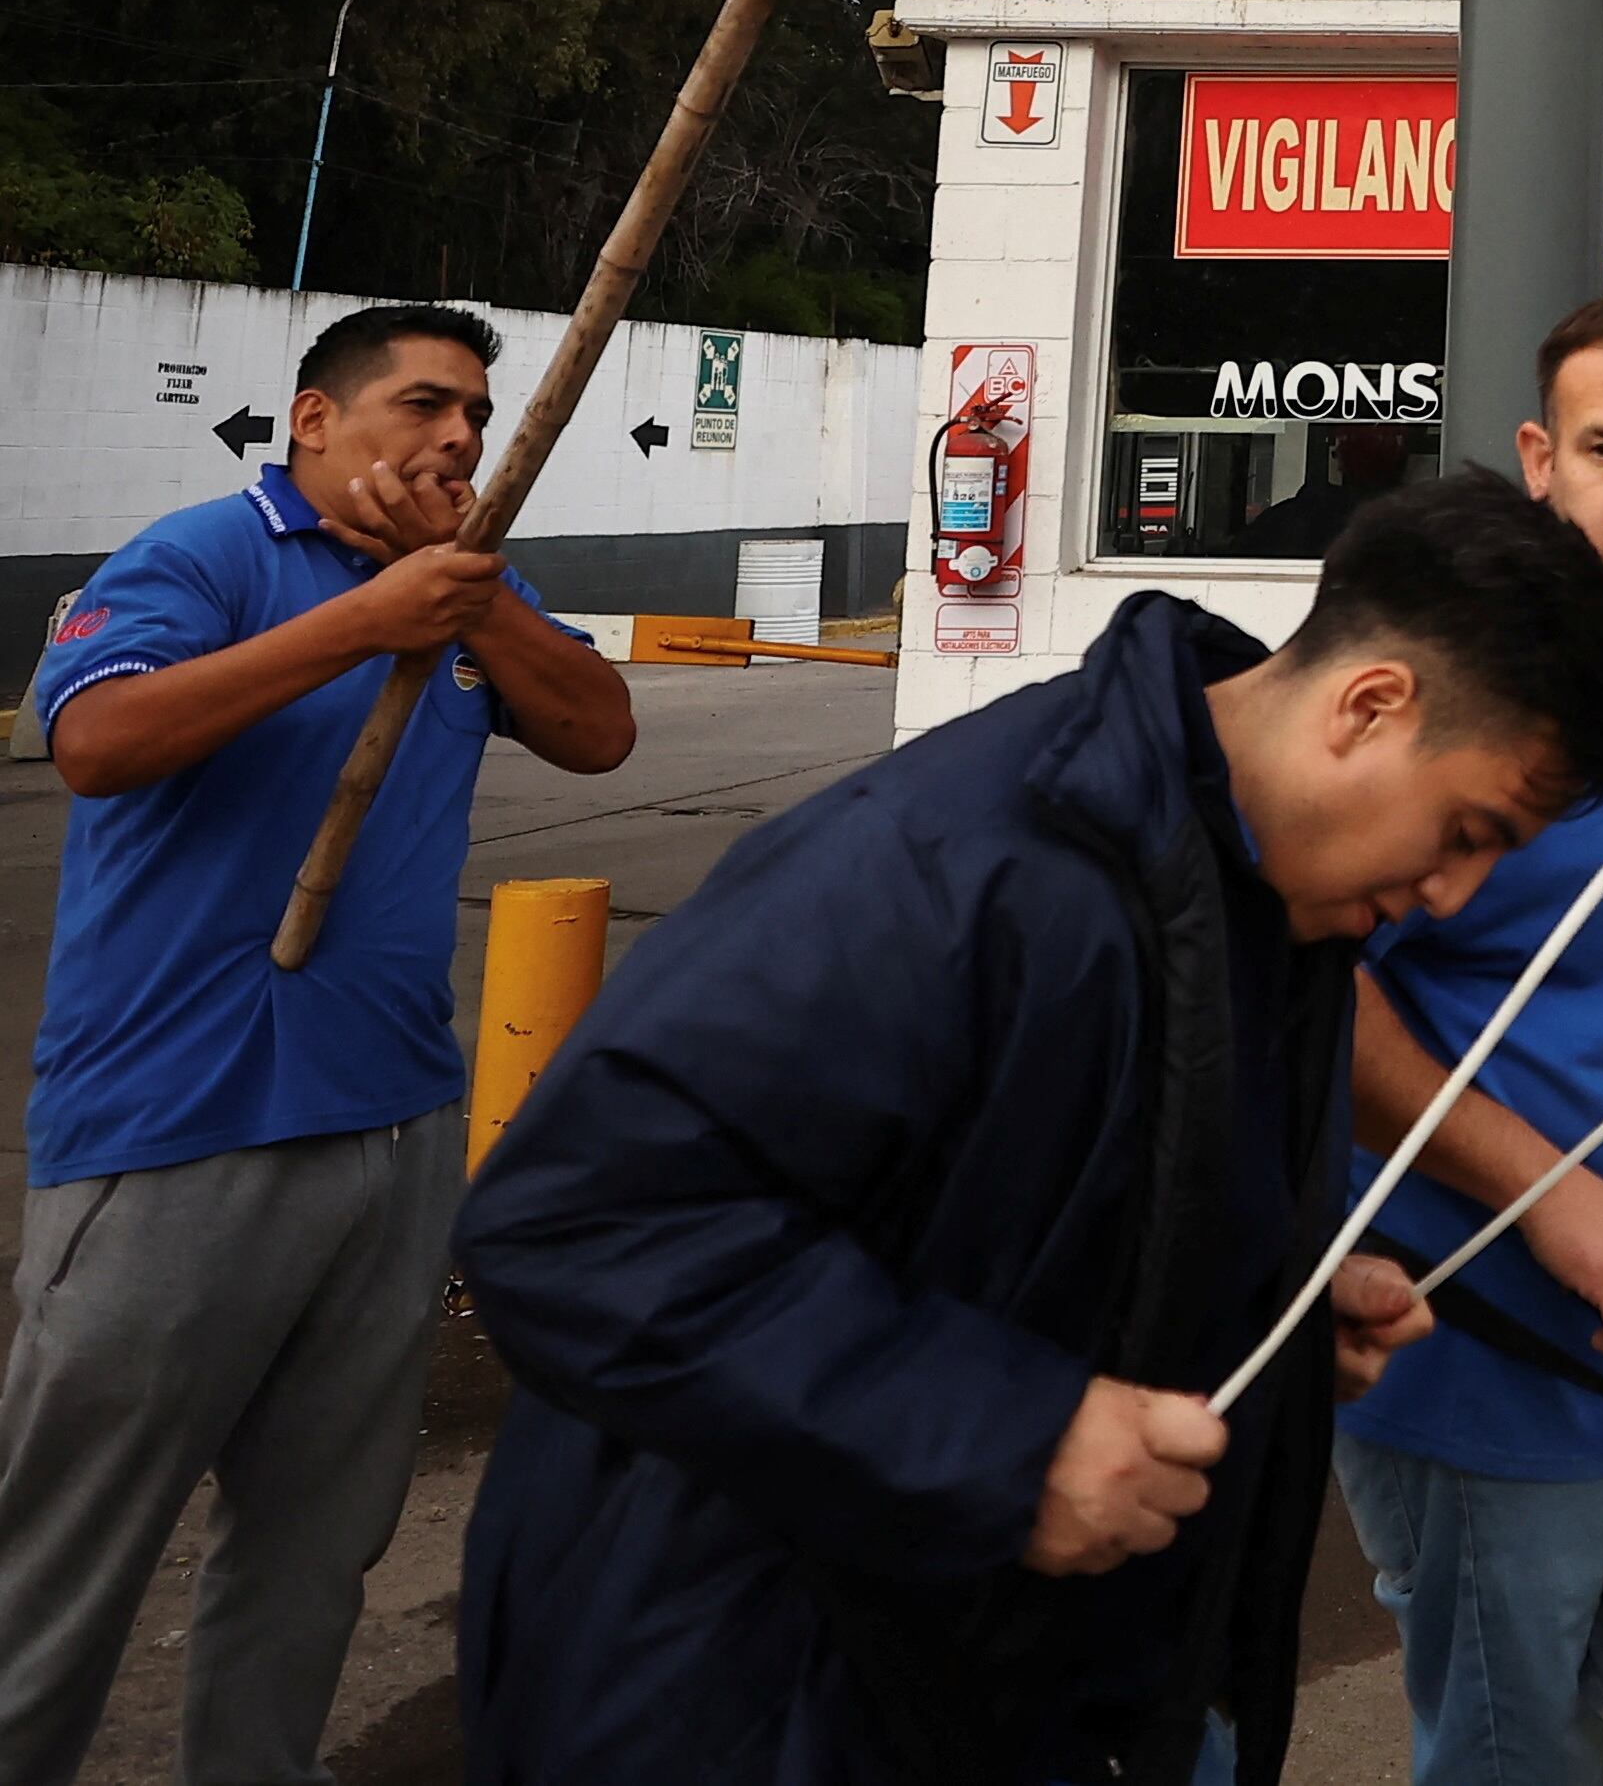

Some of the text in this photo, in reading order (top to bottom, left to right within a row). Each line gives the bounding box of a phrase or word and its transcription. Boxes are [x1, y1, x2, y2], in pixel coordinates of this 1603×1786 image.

[997, 65, 1052, 79] MATAFUEGO
[1210, 360, 1439, 420] MONS
[156, 391, 200, 405] CARTELES
[696, 417, 735, 430] PUNTO DE
